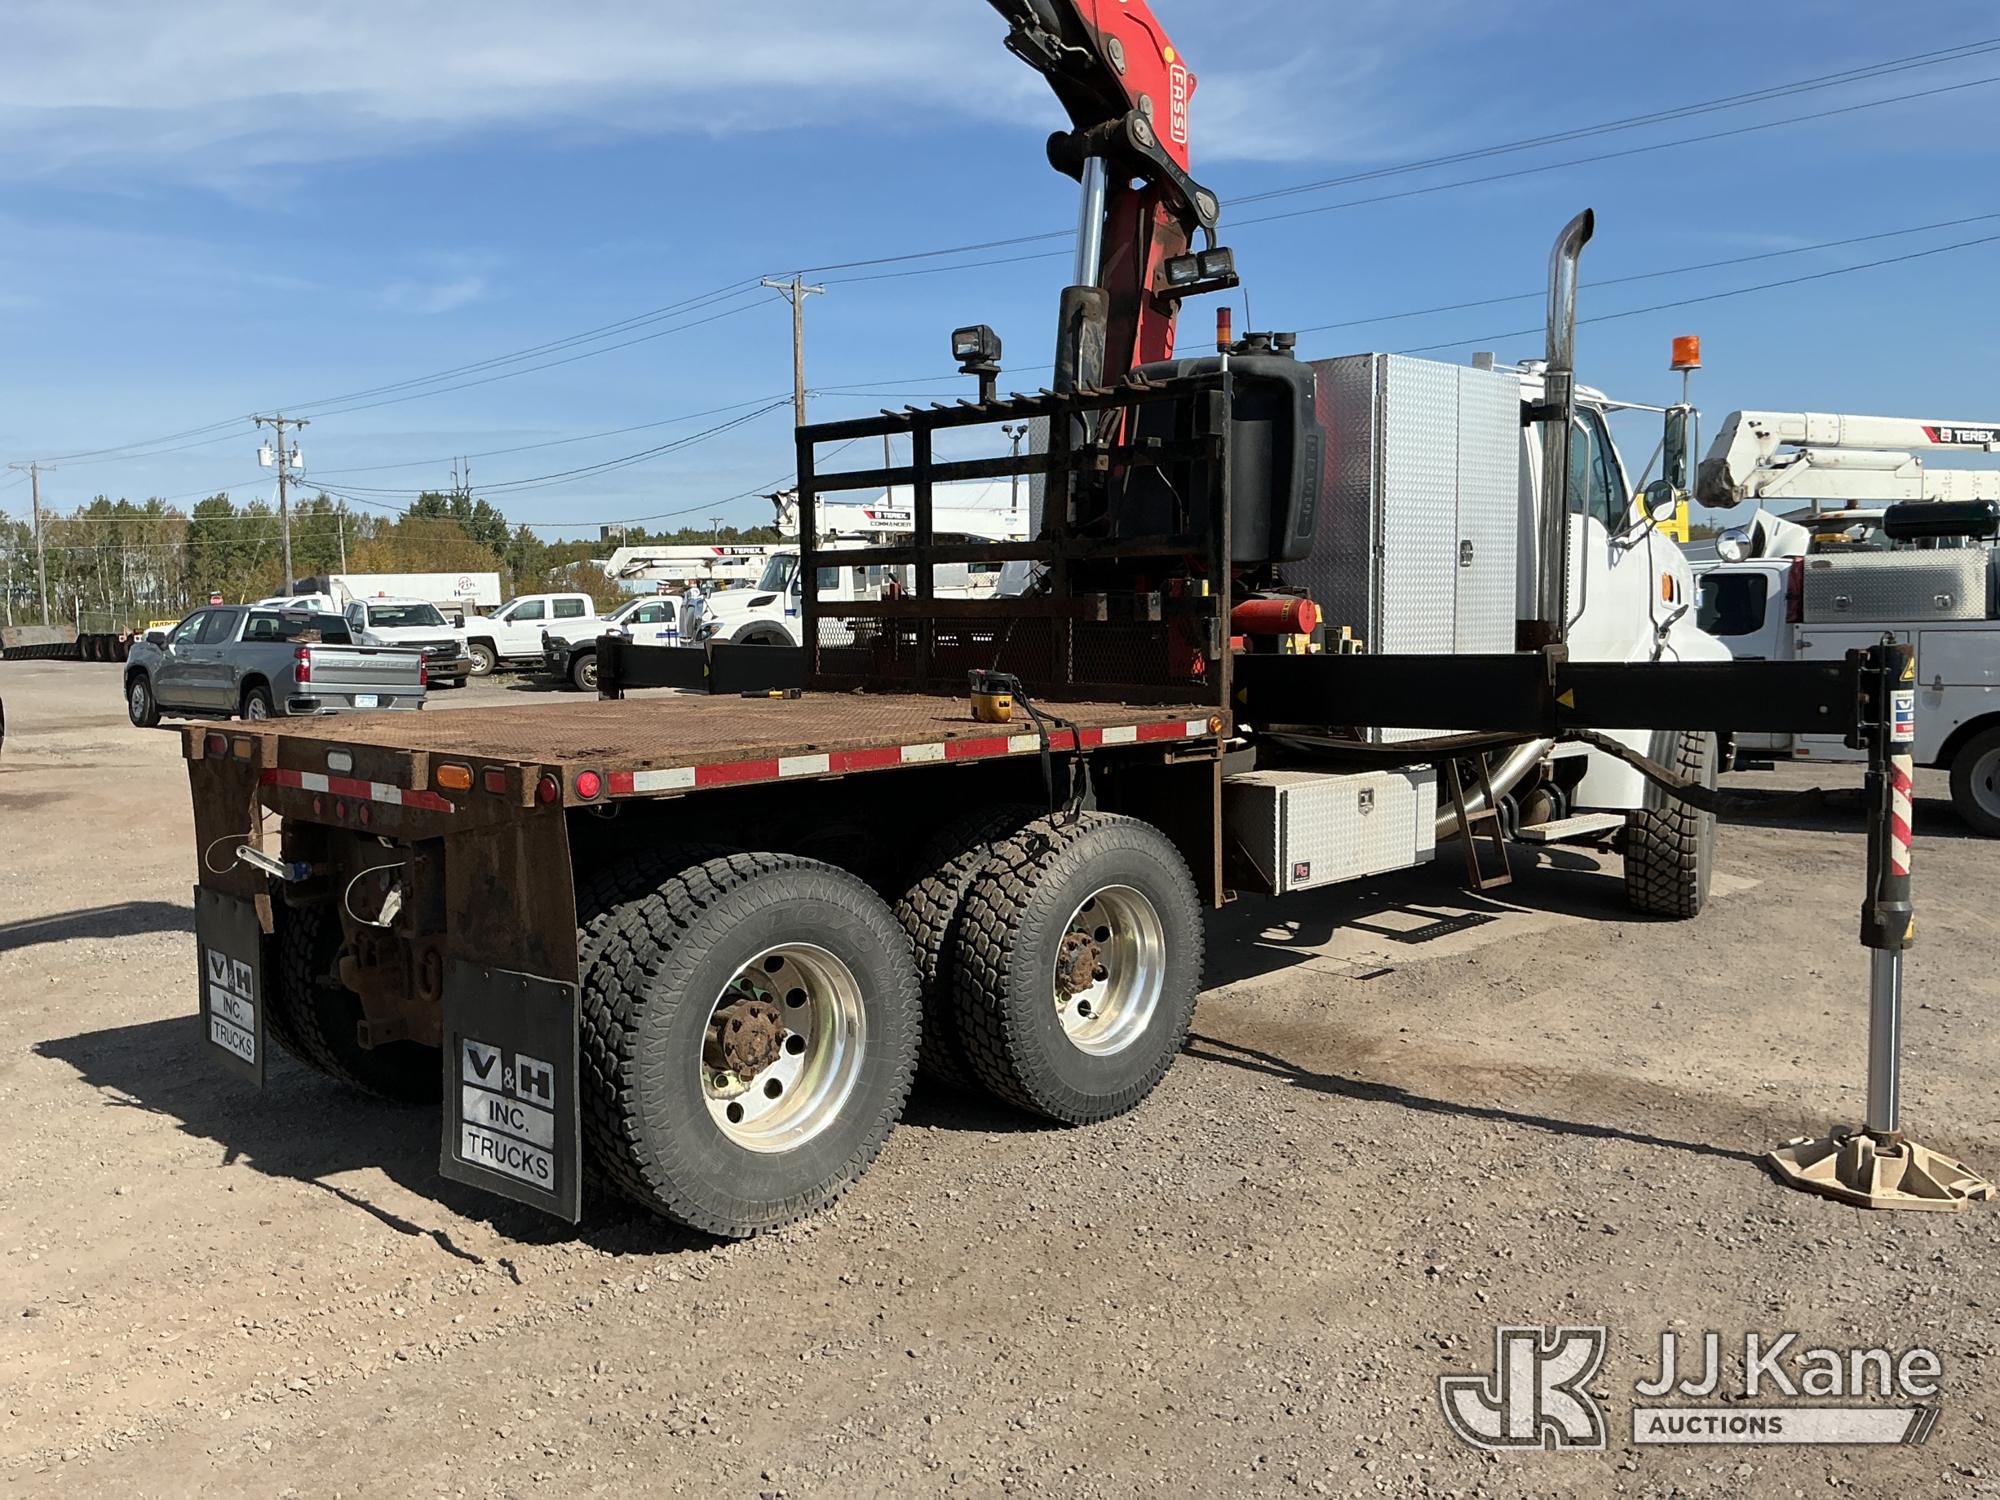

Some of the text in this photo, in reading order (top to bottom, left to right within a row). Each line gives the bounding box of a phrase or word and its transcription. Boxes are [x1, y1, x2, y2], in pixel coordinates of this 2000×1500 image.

[1172, 71, 1185, 137] FASSI
[1953, 429, 1994, 443] TEREX
[765, 903, 875, 954] TOYO
[223, 996, 244, 1020] INC.
[213, 1020, 253, 1057] TRUCKS
[489, 1100, 530, 1134] INC.
[467, 1132, 550, 1180] TRUCKS
